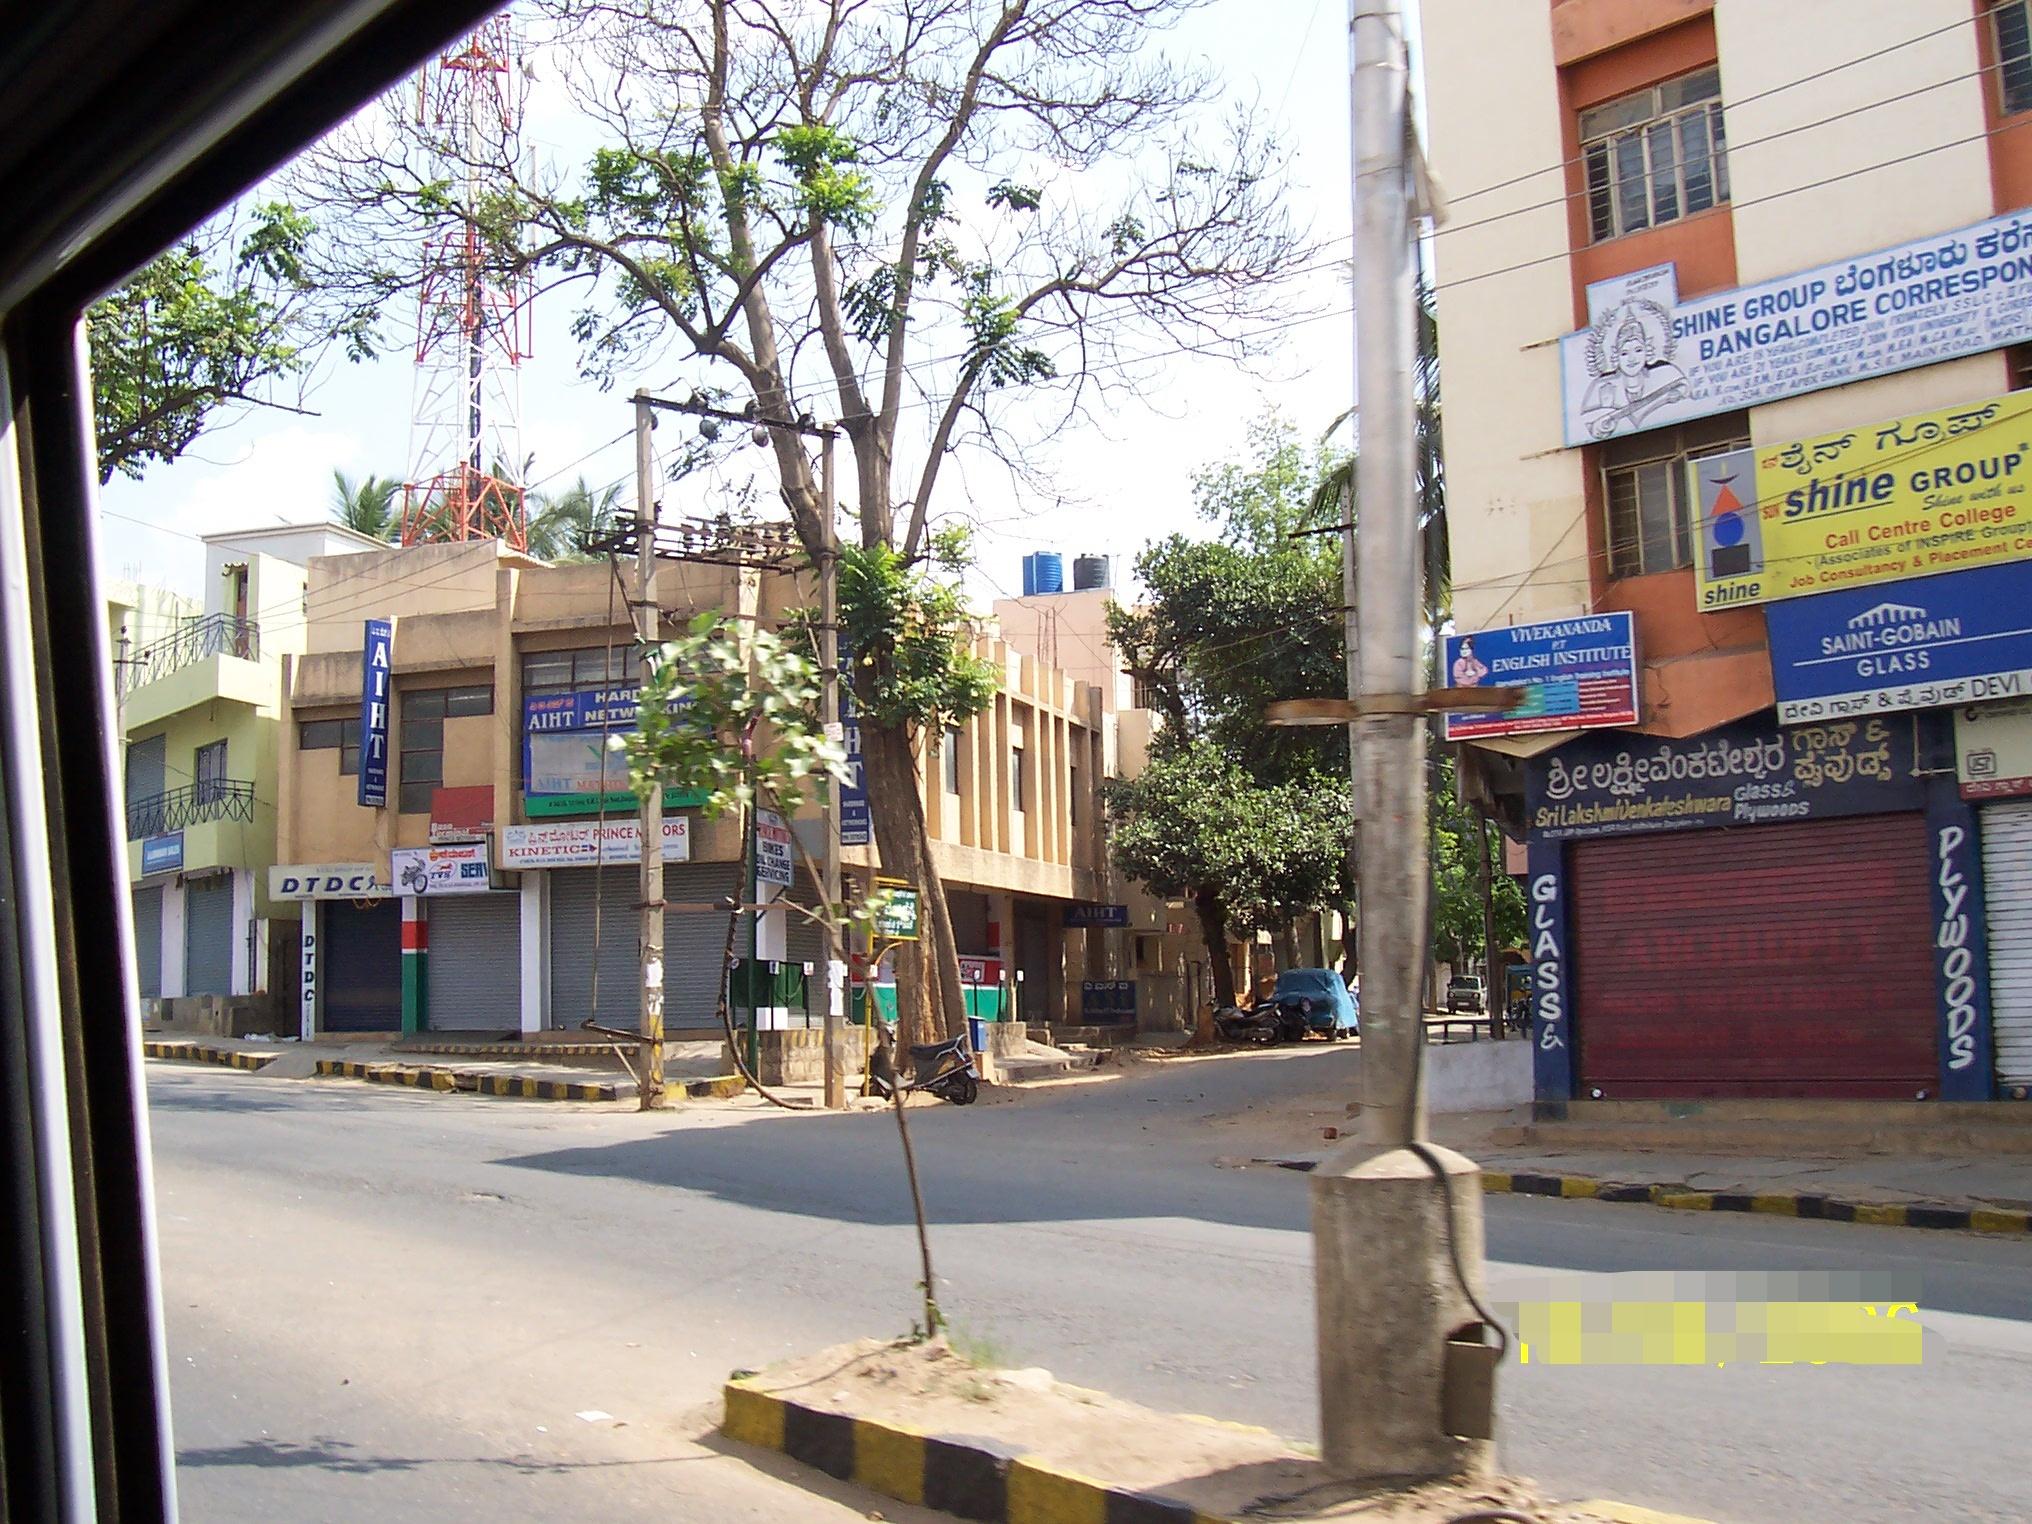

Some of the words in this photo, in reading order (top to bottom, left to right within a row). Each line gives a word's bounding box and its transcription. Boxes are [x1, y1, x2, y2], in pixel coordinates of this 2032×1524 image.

[1673, 304, 1736, 339] SHINE
[1744, 281, 1825, 320] GROUP
[1836, 240, 1967, 296] ಬೆಂಗಳೂರು
[1701, 299, 1867, 361] BANGALORE
[1785, 473, 1895, 517] shine
[1911, 453, 2021, 493] GROUP
[1825, 529, 1859, 549] Call
[1868, 519, 1931, 541] Centre
[1940, 505, 2016, 529] College
[1897, 540, 1911, 553] of
[1917, 528, 1976, 549] INSPIRE
[1790, 574, 1815, 588] Job
[1820, 559, 1906, 583] Consultancy
[1913, 555, 1922, 568] &
[1929, 541, 2008, 564] Placement
[1704, 582, 1761, 605] shine
[1511, 618, 1611, 644] VIVEKANANDA
[1822, 618, 1962, 655] SAINT-GOBAIN
[1492, 653, 1550, 673] ENGLISH
[1553, 645, 1632, 667] INSTITUTE
[1857, 651, 1931, 677] GLASS
[370, 642, 389, 759] AIHT
[1877, 692, 1892, 708] &
[1971, 673, 2020, 698] DEVI
[528, 711, 575, 730] AIHT
[1535, 805, 1559, 828] Sri
[593, 827, 633, 841] PRINCE
[509, 844, 581, 858] KINETIC
[763, 840, 784, 857] BIKES
[430, 870, 451, 879] TVS
[756, 865, 790, 883] SERVICING
[767, 857, 791, 871] CHANGE
[281, 875, 364, 893] DTDC
[1532, 874, 1562, 1020] GLASS
[1938, 825, 1976, 1070] PLYWOODS
[305, 935, 314, 1001] DTDC
[1540, 1024, 1564, 1049] &
